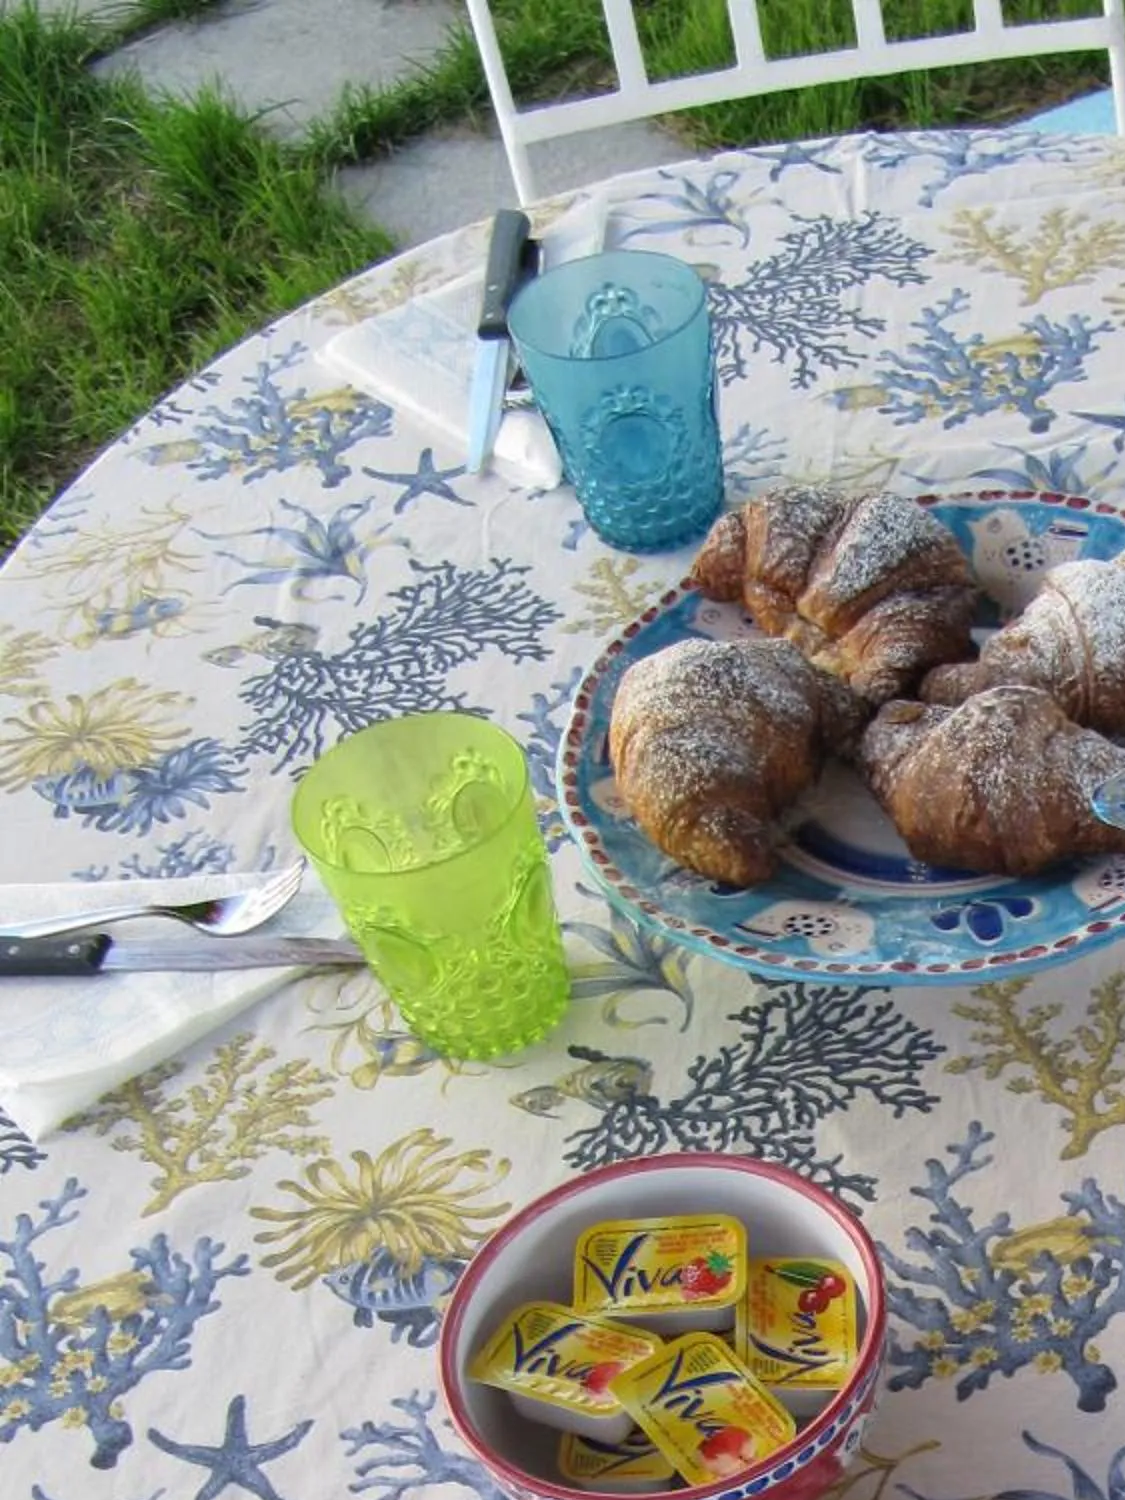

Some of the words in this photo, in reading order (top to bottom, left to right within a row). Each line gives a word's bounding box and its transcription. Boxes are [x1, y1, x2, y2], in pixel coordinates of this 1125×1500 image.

[582, 1233, 683, 1303] Viva
[513, 1321, 593, 1381] Viva
[749, 1311, 838, 1384] Viva
[650, 1348, 742, 1438] Viva
